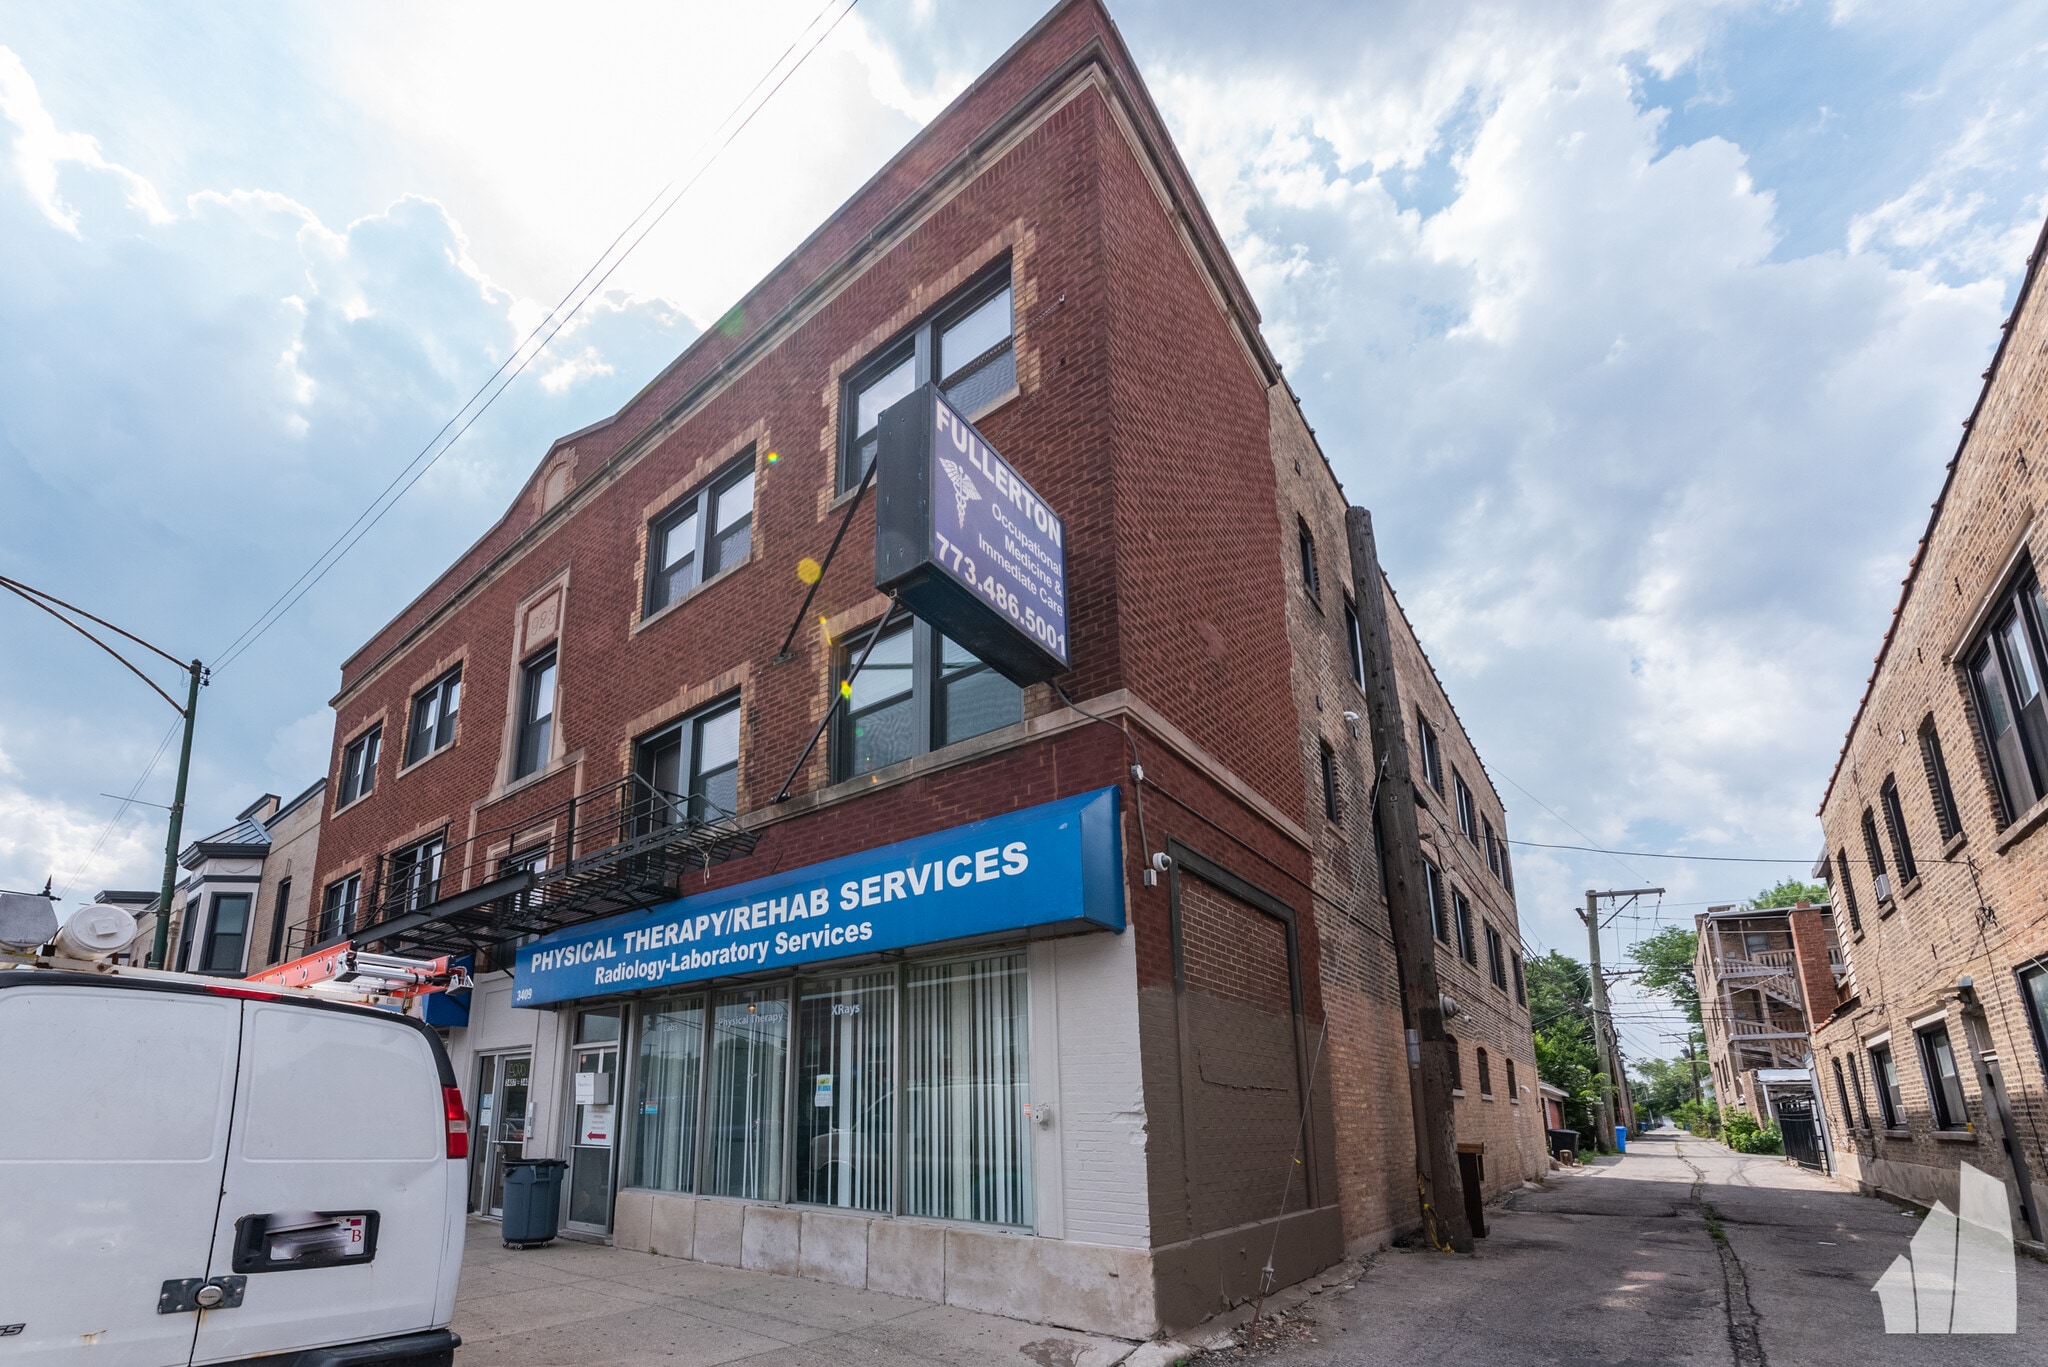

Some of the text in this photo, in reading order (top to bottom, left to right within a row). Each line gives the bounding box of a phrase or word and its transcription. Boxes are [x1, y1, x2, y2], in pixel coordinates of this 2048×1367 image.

[936, 399, 1061, 548] FULLERTON
[992, 503, 1062, 577] Occupational
[1005, 535, 1063, 598] Medicine &
[936, 532, 1066, 657] 773.486.5001
[979, 532, 1064, 617] Immediate Care
[531, 841, 1029, 973] PHYSICAL THERAPY/REHAB SERVICES
[595, 921, 873, 985] Radiology-Laboratory Services
[517, 988, 532, 1001] 3409
[718, 1012, 783, 1028] Physical Therapy
[831, 1004, 860, 1016] XRays
[663, 1022, 678, 1032] Labs
